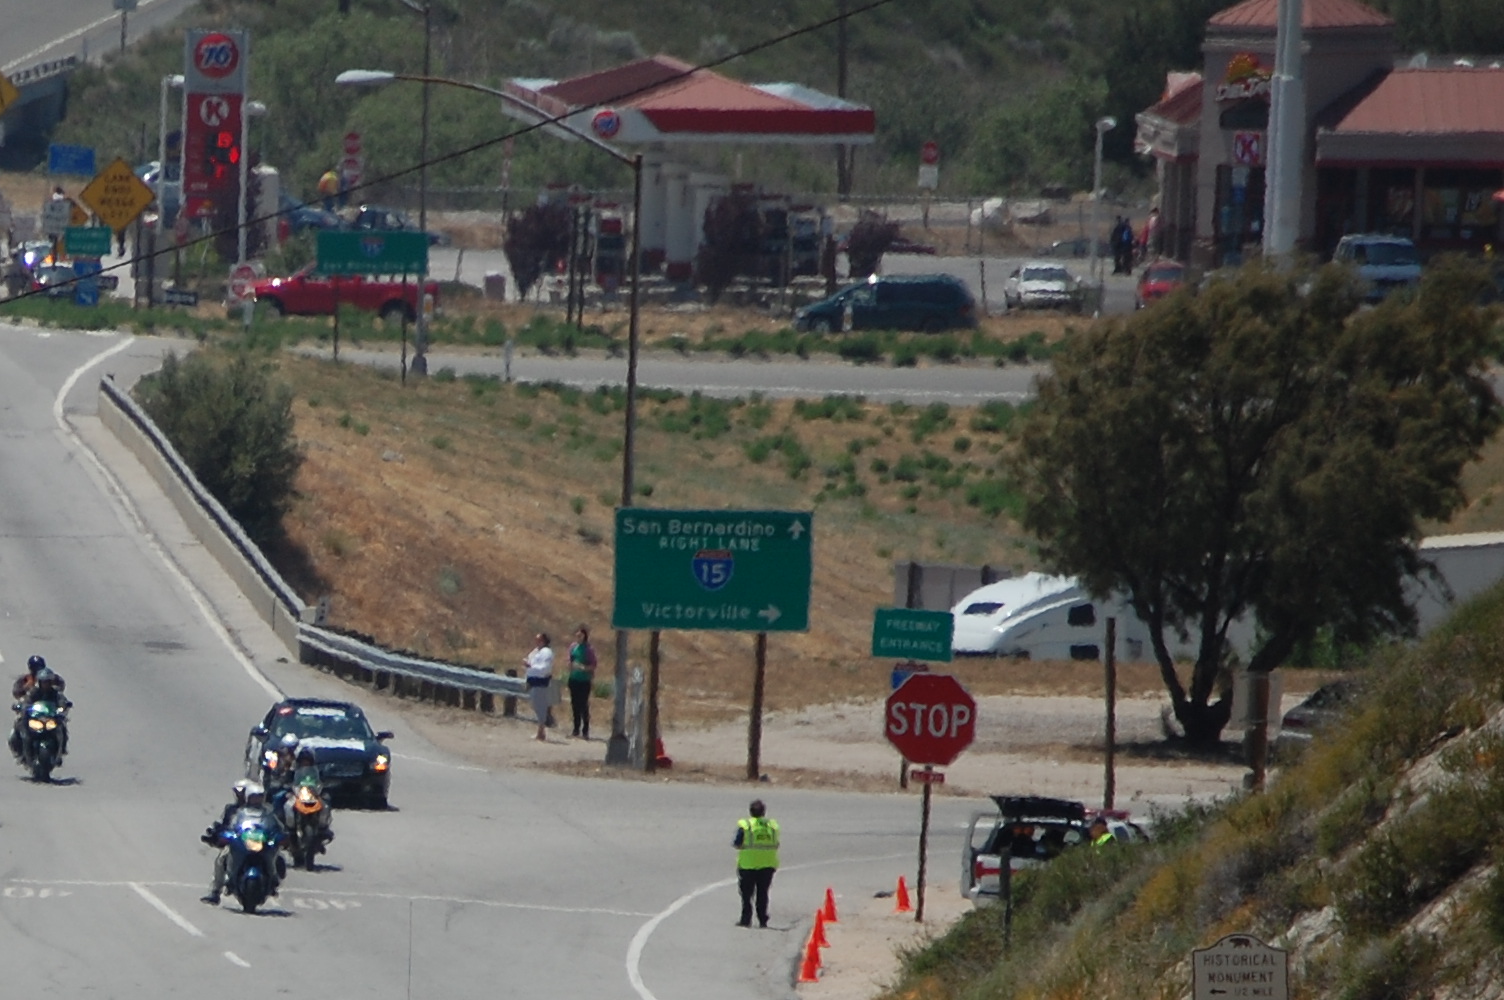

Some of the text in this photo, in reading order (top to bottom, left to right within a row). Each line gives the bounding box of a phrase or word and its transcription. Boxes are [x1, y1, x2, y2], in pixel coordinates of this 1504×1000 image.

[200, 41, 232, 69] 76
[623, 518, 775, 537] San Bernardino
[659, 537, 760, 551] RIGHT LANE
[702, 562, 726, 583] 15
[641, 603, 751, 619] Victorville
[886, 619, 941, 632] FREEWAY
[880, 637, 943, 653] ENTRANCE
[889, 702, 971, 738] STOP
[1203, 954, 1276, 966] HISTORICAL
[1208, 971, 1274, 983] MONUMENT
[1234, 987, 1273, 996] 1/2 MILE
